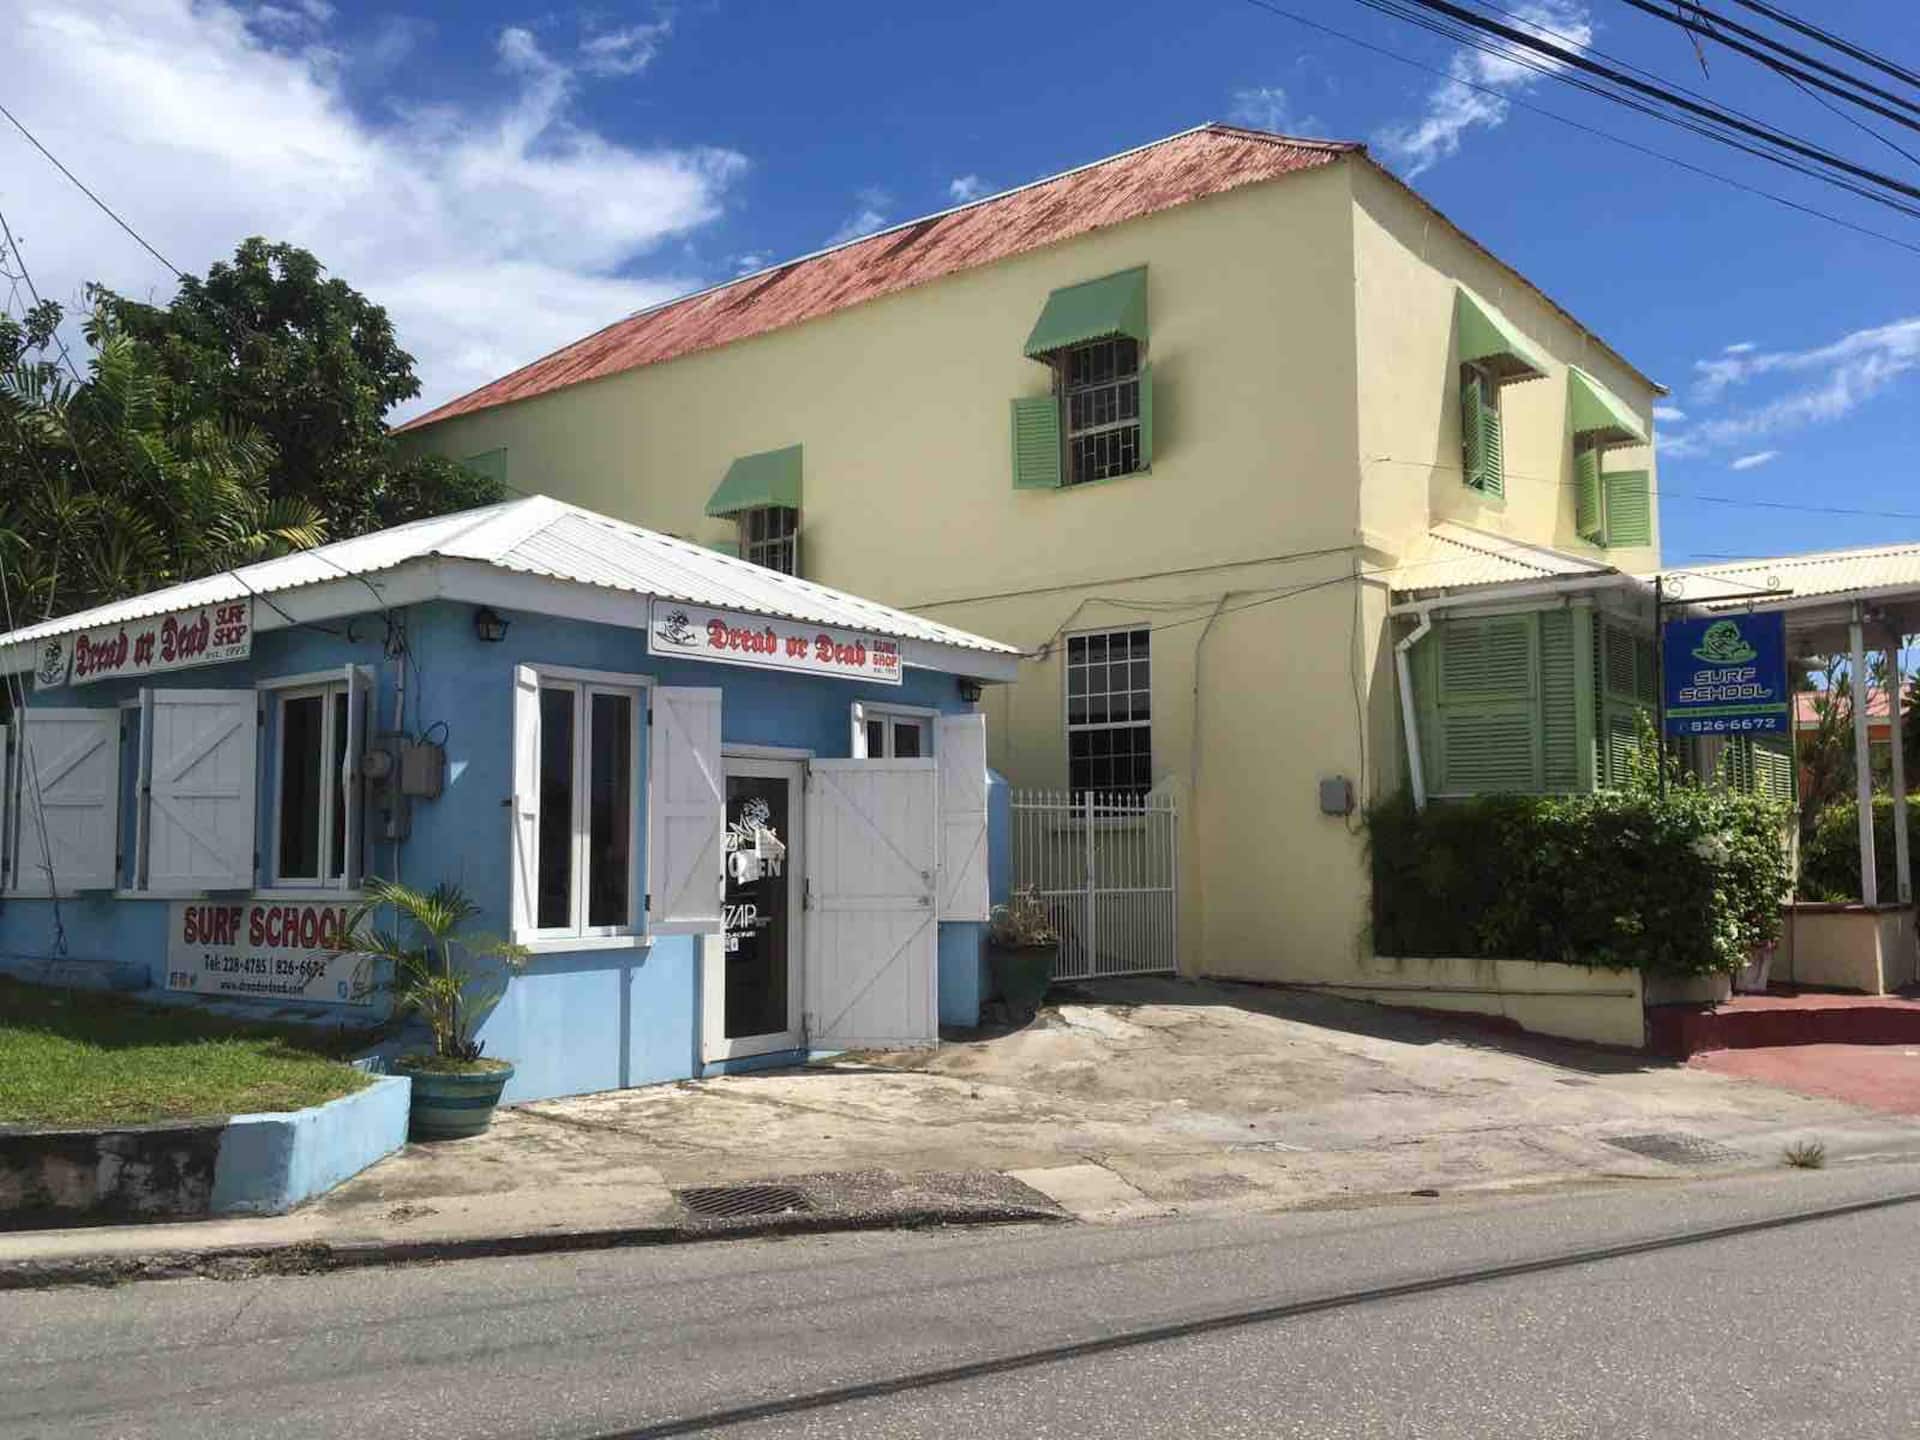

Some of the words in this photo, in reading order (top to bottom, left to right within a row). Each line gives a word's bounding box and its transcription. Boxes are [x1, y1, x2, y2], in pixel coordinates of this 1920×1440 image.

[75, 628, 129, 677] Dread
[134, 635, 156, 667] or
[160, 612, 210, 663] Dead
[213, 625, 247, 646] SHOP
[706, 619, 777, 654] Dread
[786, 636, 807, 659] or
[815, 635, 866, 667] Dead
[872, 654, 897, 667] SHOP
[1694, 667, 1756, 685] SURF
[1679, 684, 1773, 702] SCHOOL
[1691, 718, 1776, 731] 826-6672
[728, 851, 781, 877] OEN
[183, 906, 243, 945] SURF
[249, 906, 347, 950] SCHOOL
[205, 954, 220, 971] Tel:
